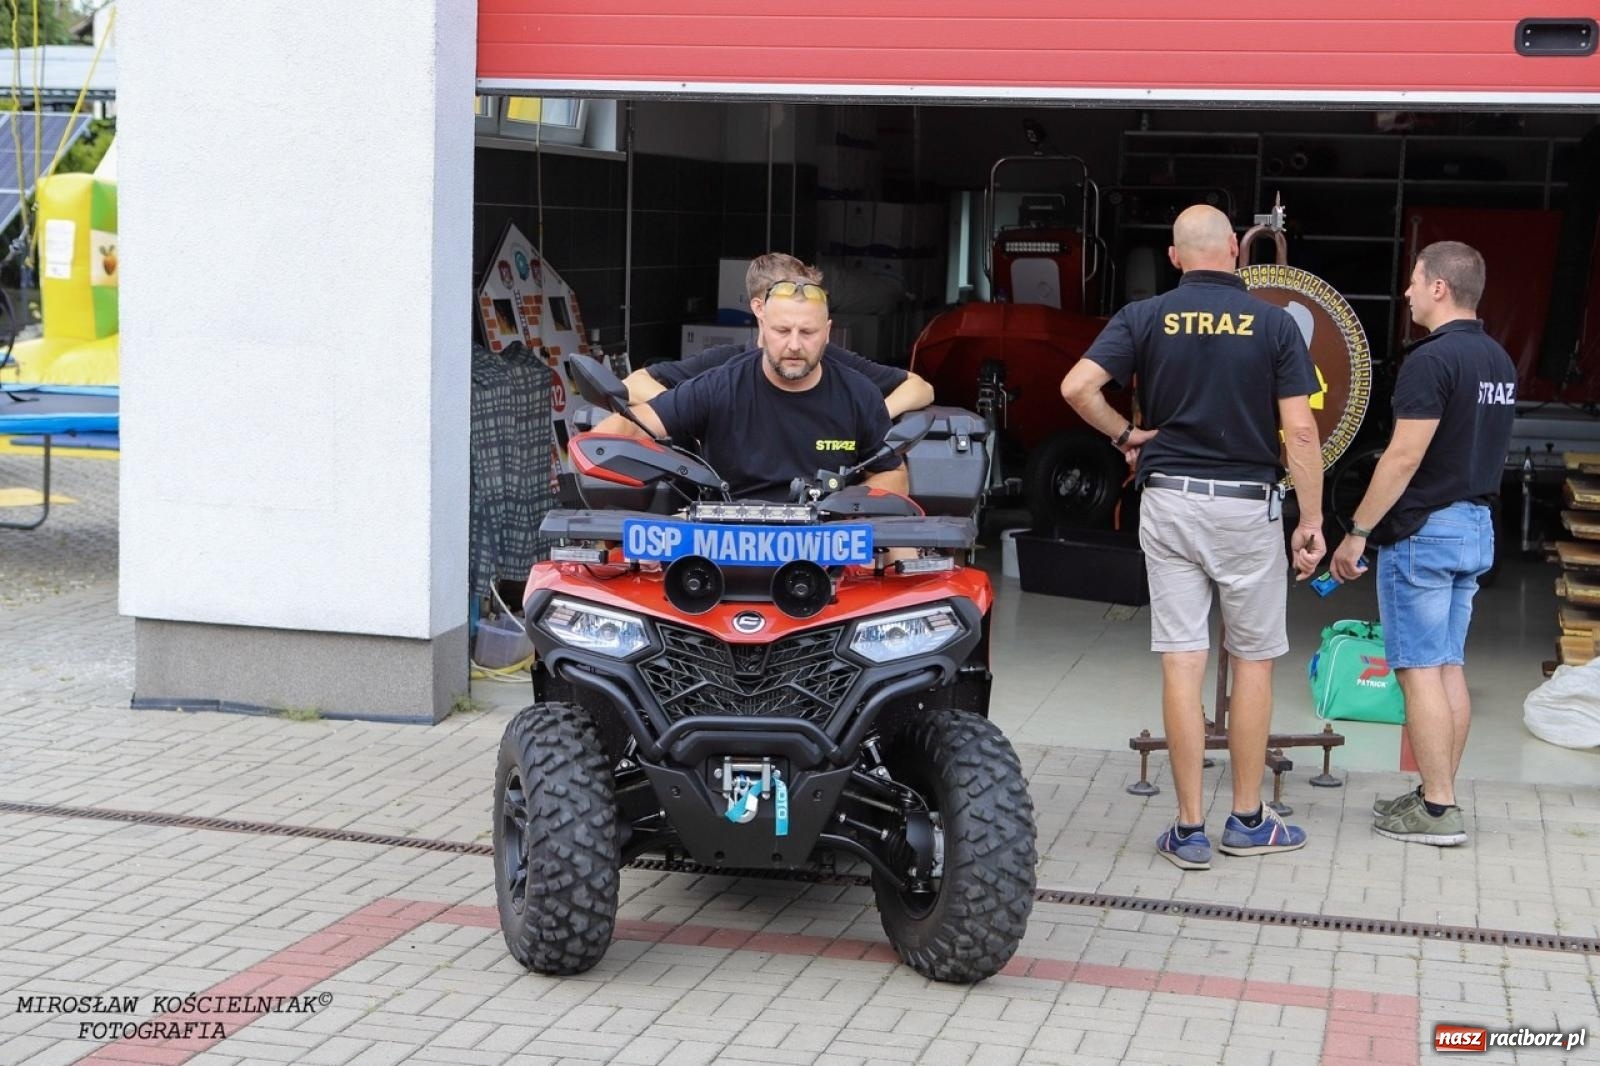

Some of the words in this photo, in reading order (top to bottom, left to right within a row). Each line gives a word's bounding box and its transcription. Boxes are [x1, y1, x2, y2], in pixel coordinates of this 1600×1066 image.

[1164, 312, 1255, 336] STRAZ
[629, 524, 682, 557] OSP
[694, 528, 867, 562] MARKOWICE
